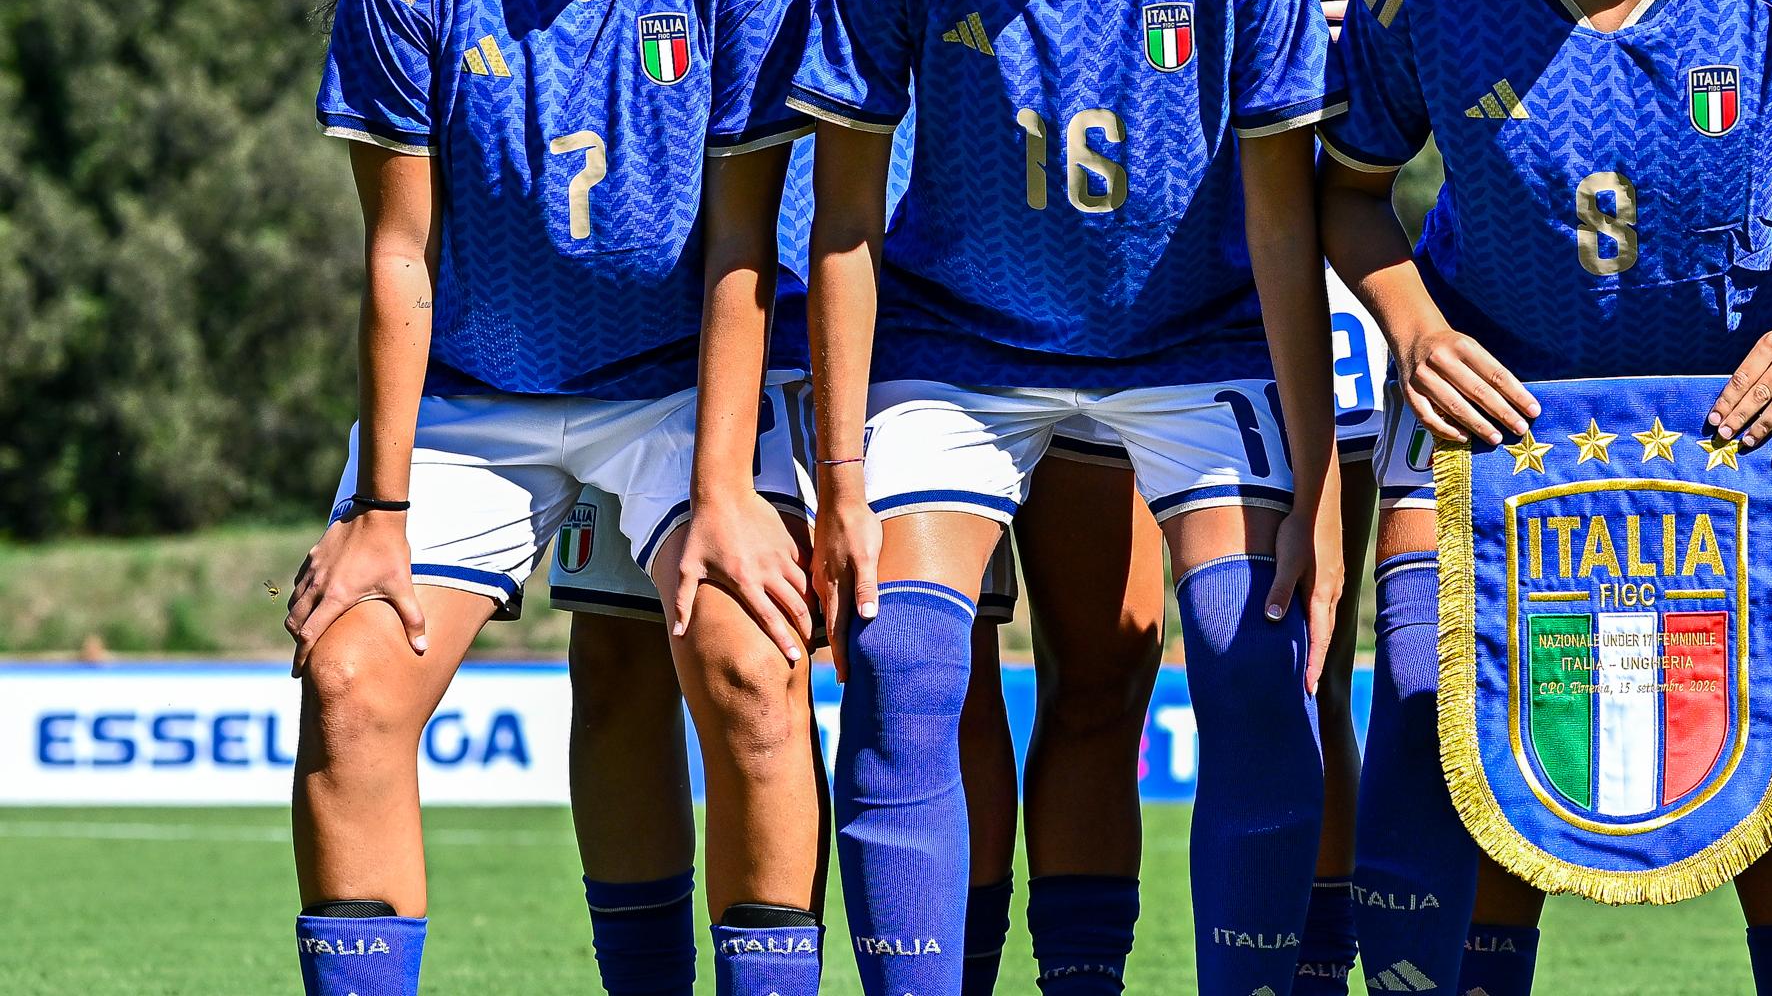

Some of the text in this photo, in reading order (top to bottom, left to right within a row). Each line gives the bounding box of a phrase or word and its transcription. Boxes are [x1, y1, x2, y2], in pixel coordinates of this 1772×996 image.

[1147, 8, 1190, 23] ITALIA
[642, 18, 685, 34] ITALIA
[1693, 71, 1735, 86] ITALIA
[1016, 107, 1128, 213] 16
[550, 130, 607, 240] 7
[1575, 171, 1638, 276] 8
[1527, 514, 1726, 578] ITALIA
[1599, 583, 1656, 608] FIGC
[1539, 632, 1717, 648] NAZIONALE UNDER 17 FEMMINILE
[1561, 657, 1604, 671] ITALIA
[1621, 656, 1694, 670] UNGHERIA
[1539, 682, 1565, 695] CPO
[1619, 682, 1631, 694] 15
[1689, 680, 1717, 693] 2026
[38, 710, 531, 768] ESSELGA
[1350, 885, 1441, 911] ITALIA
[299, 937, 390, 955] ITALIA
[719, 937, 819, 955] ITALIA
[857, 936, 942, 956] ITALIA
[1214, 927, 1300, 949] ITALIA
[1296, 963, 1347, 980] ALIA
